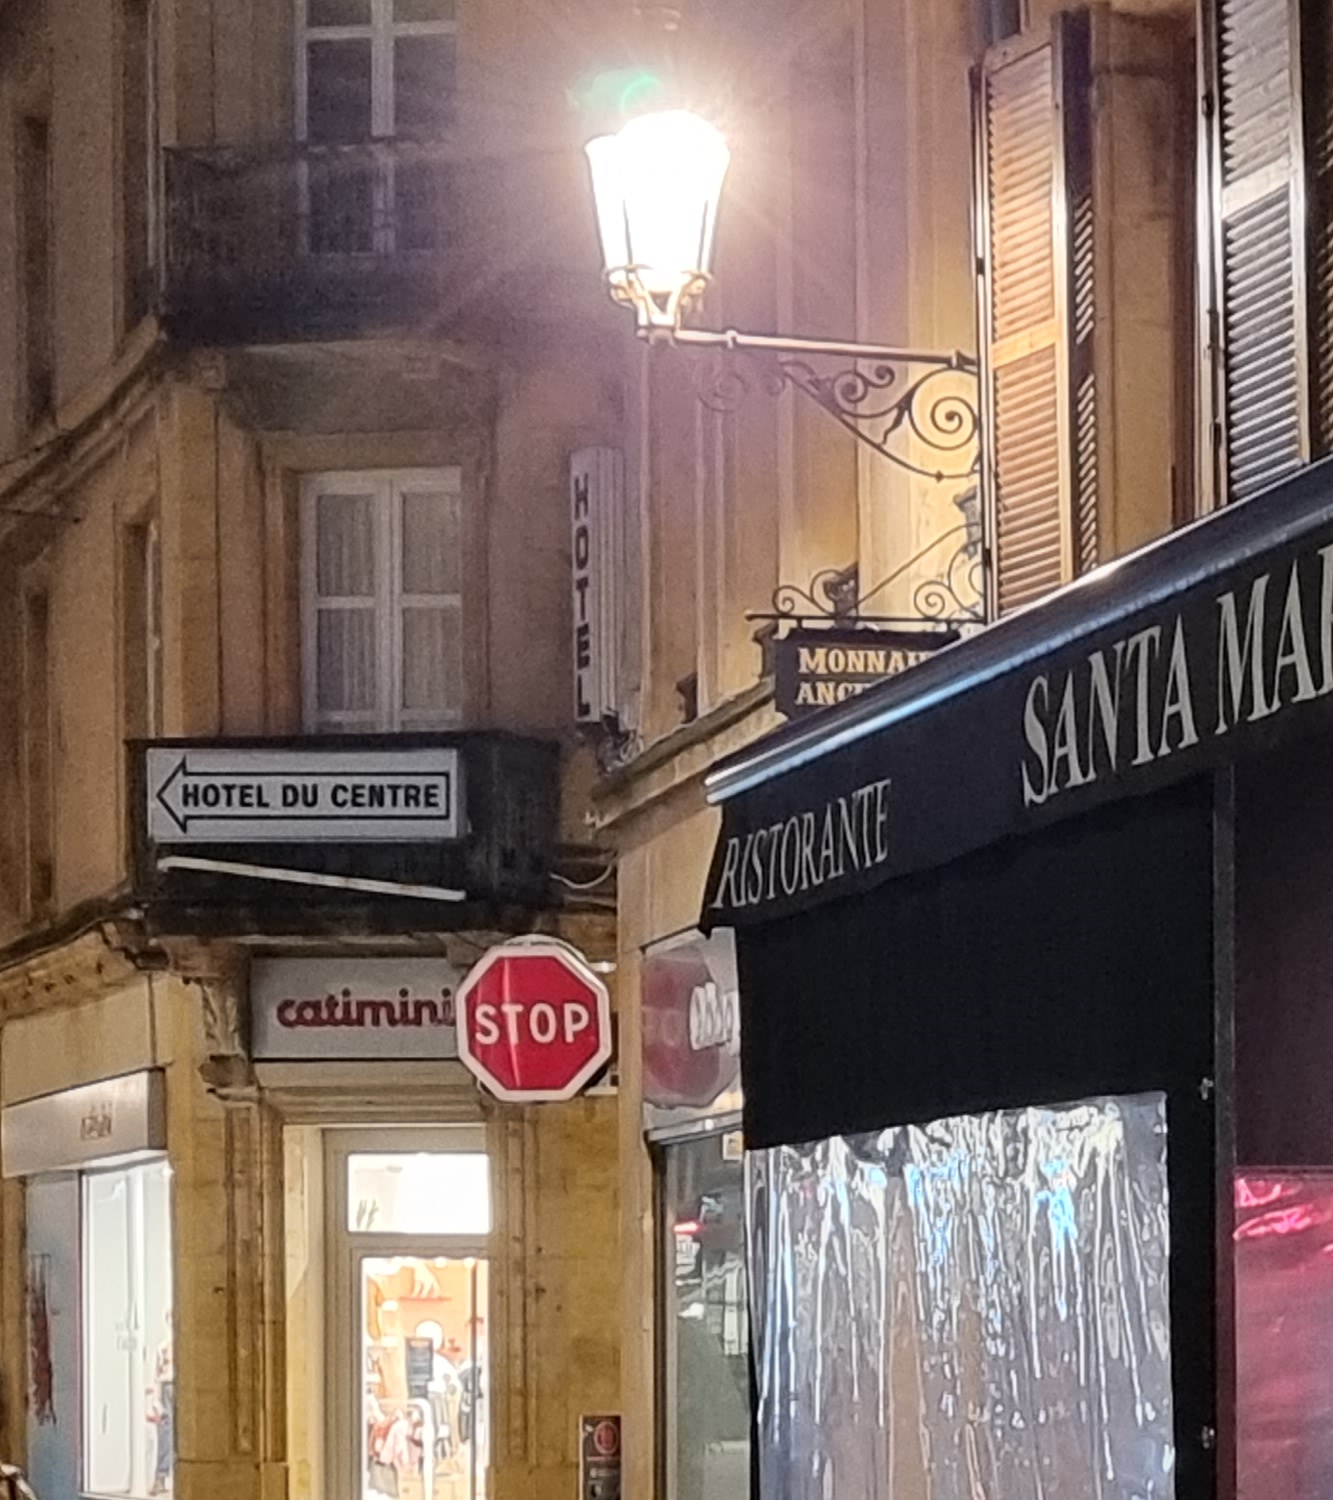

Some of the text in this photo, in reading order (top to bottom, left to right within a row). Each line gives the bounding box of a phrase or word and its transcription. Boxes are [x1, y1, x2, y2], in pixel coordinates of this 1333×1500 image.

[574, 472, 591, 718] HOTEL
[1022, 614, 1199, 808] SANTA
[181, 782, 440, 808] HOTEL DU CENTRE
[710, 778, 891, 908] RISTORANTE
[276, 988, 456, 1028] catimini
[475, 1002, 590, 1046] STOP
